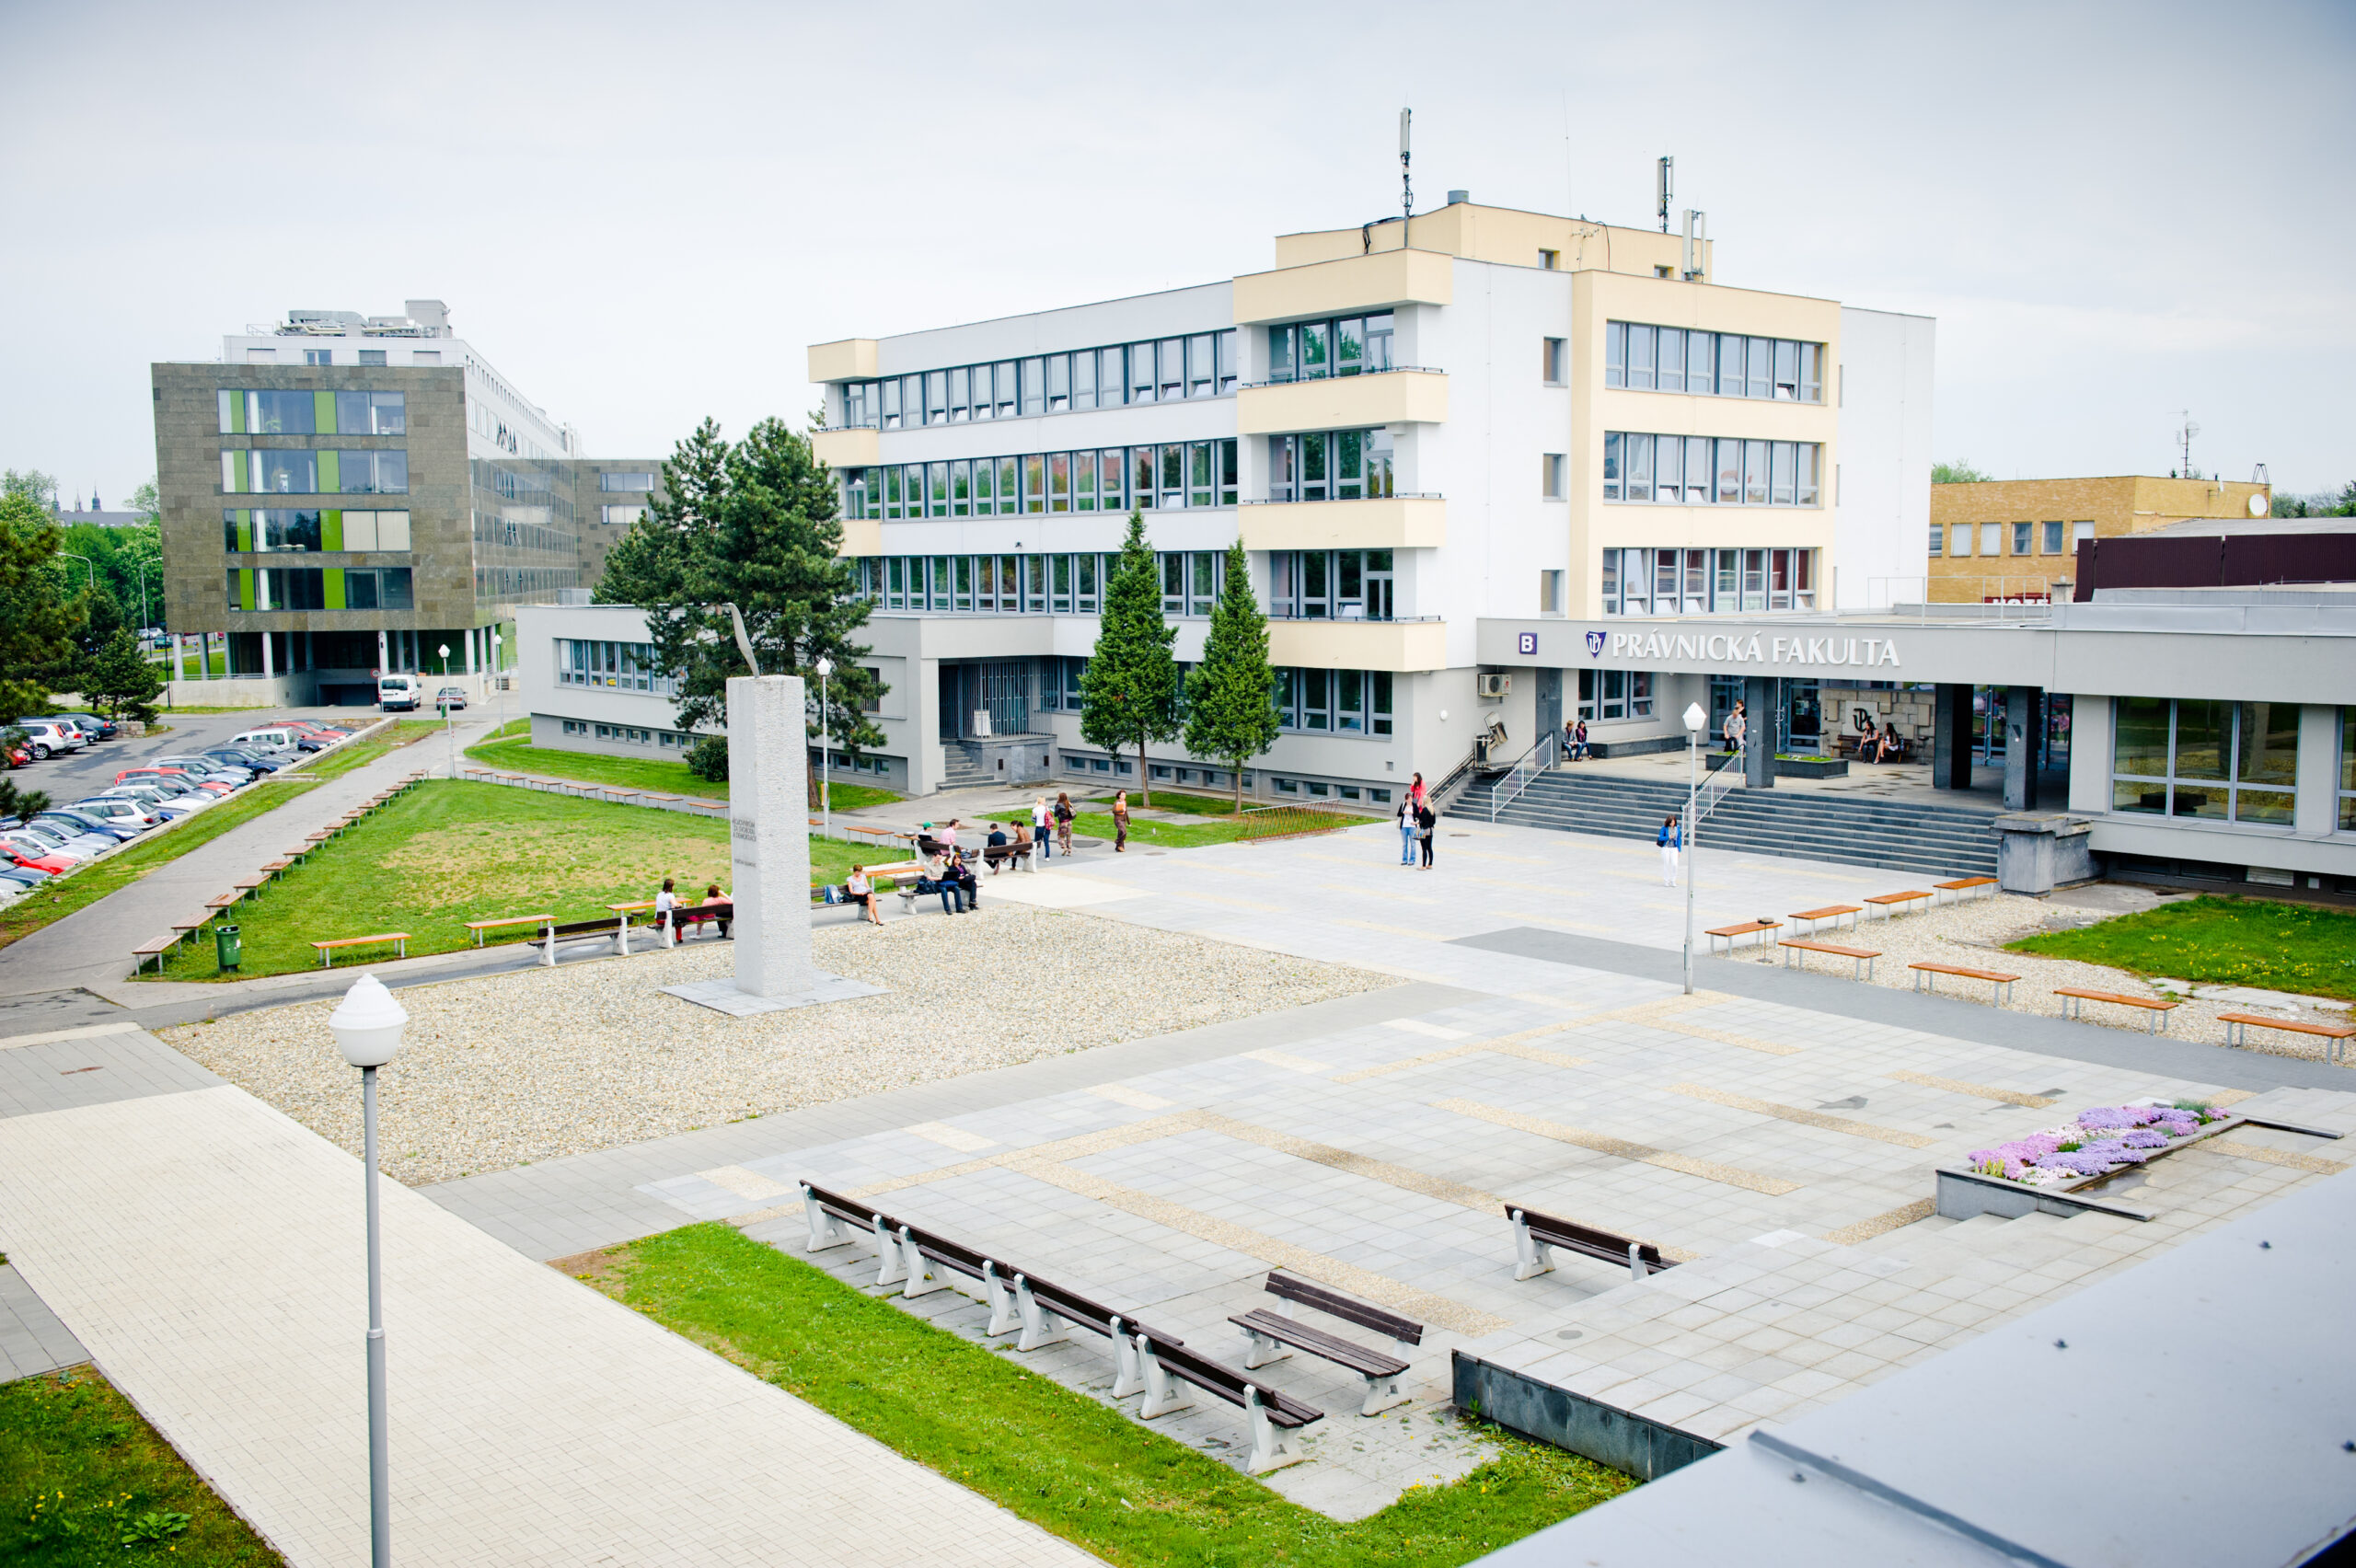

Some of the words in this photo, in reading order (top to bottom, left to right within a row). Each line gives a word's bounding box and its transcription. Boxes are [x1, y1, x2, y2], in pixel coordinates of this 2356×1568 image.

[1520, 635, 1534, 652] B
[1612, 628, 1764, 663] PRÁVNICKÁ
[1773, 637, 1900, 667] FAKULTA
